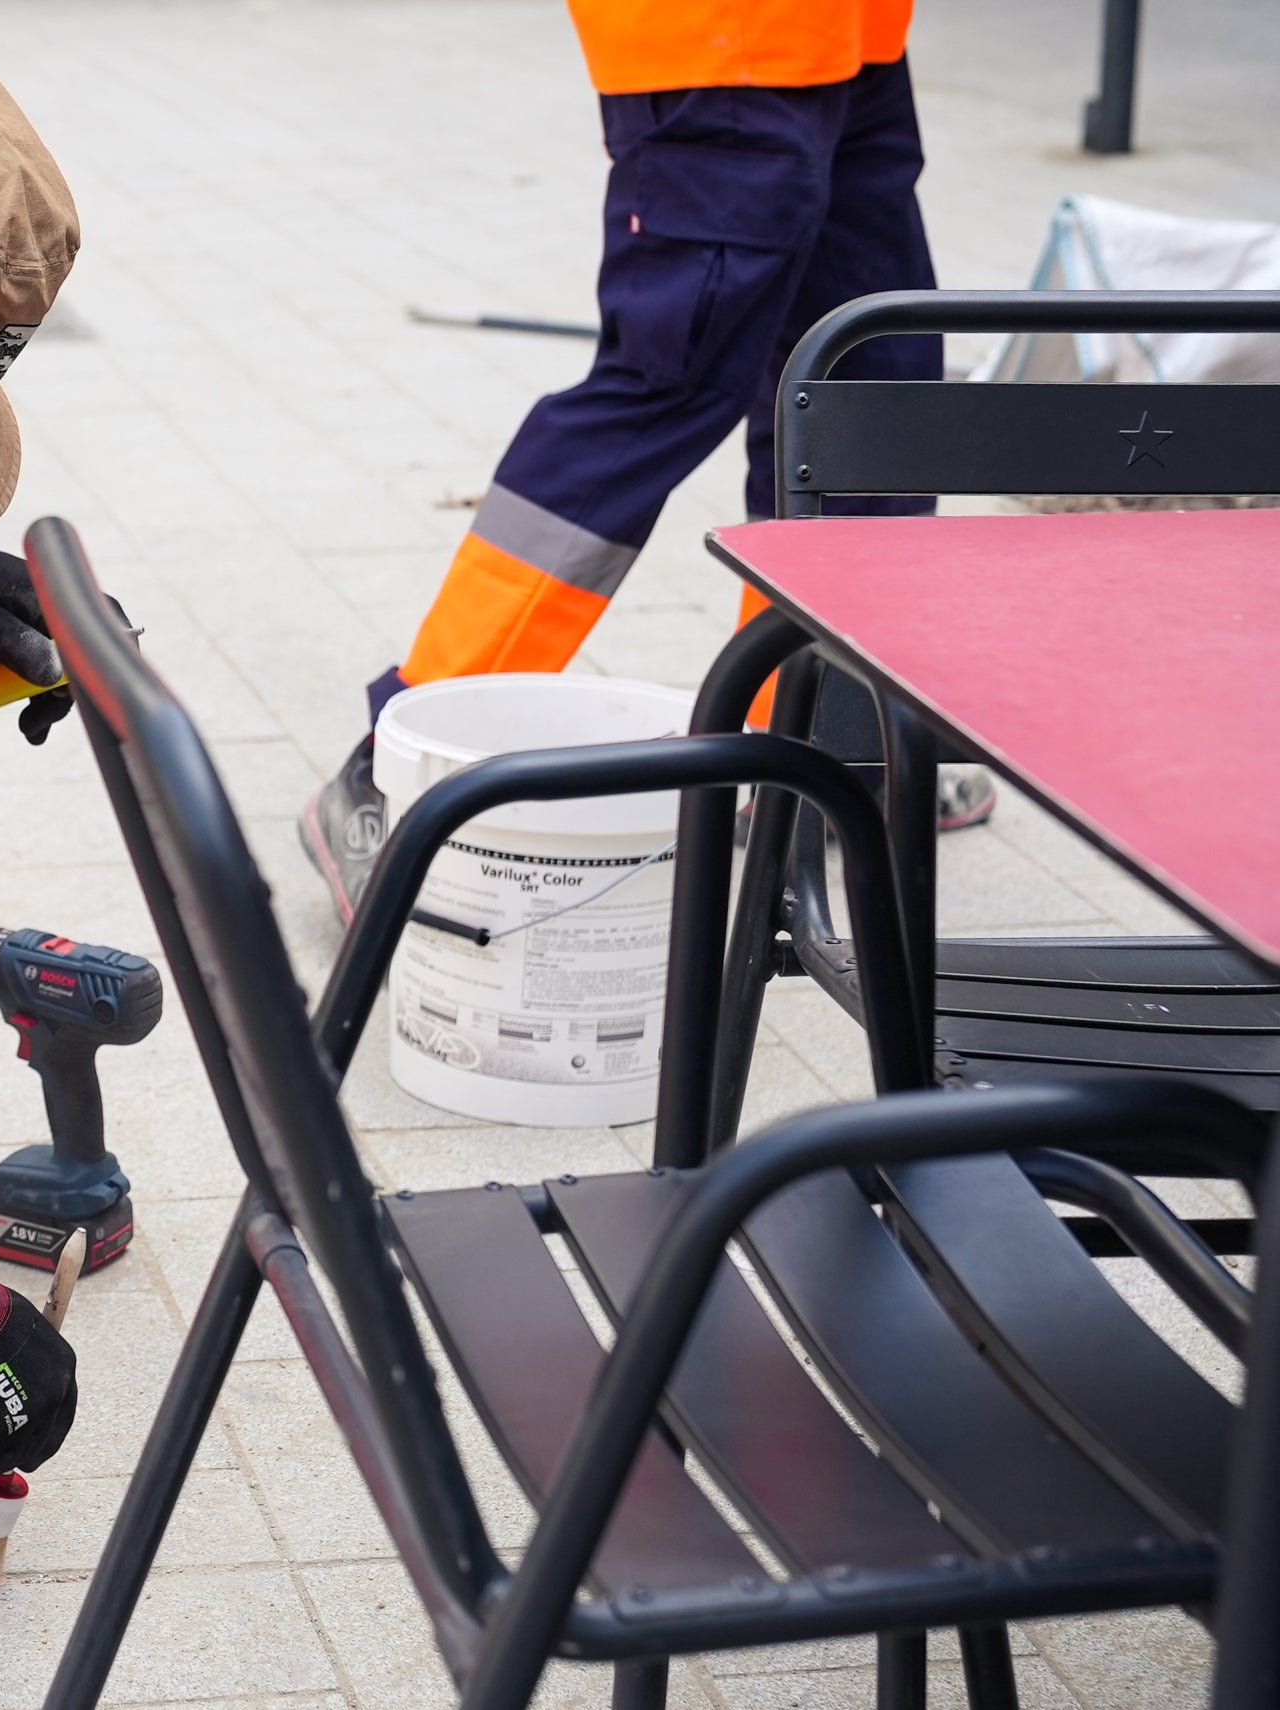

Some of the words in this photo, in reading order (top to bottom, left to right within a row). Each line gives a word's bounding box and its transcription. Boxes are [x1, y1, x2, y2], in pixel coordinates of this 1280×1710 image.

[543, 872, 584, 888] Color
[520, 884, 540, 893] SRT
[40, 970, 76, 988] BOSCH
[12, 1225, 37, 1242] 18V
